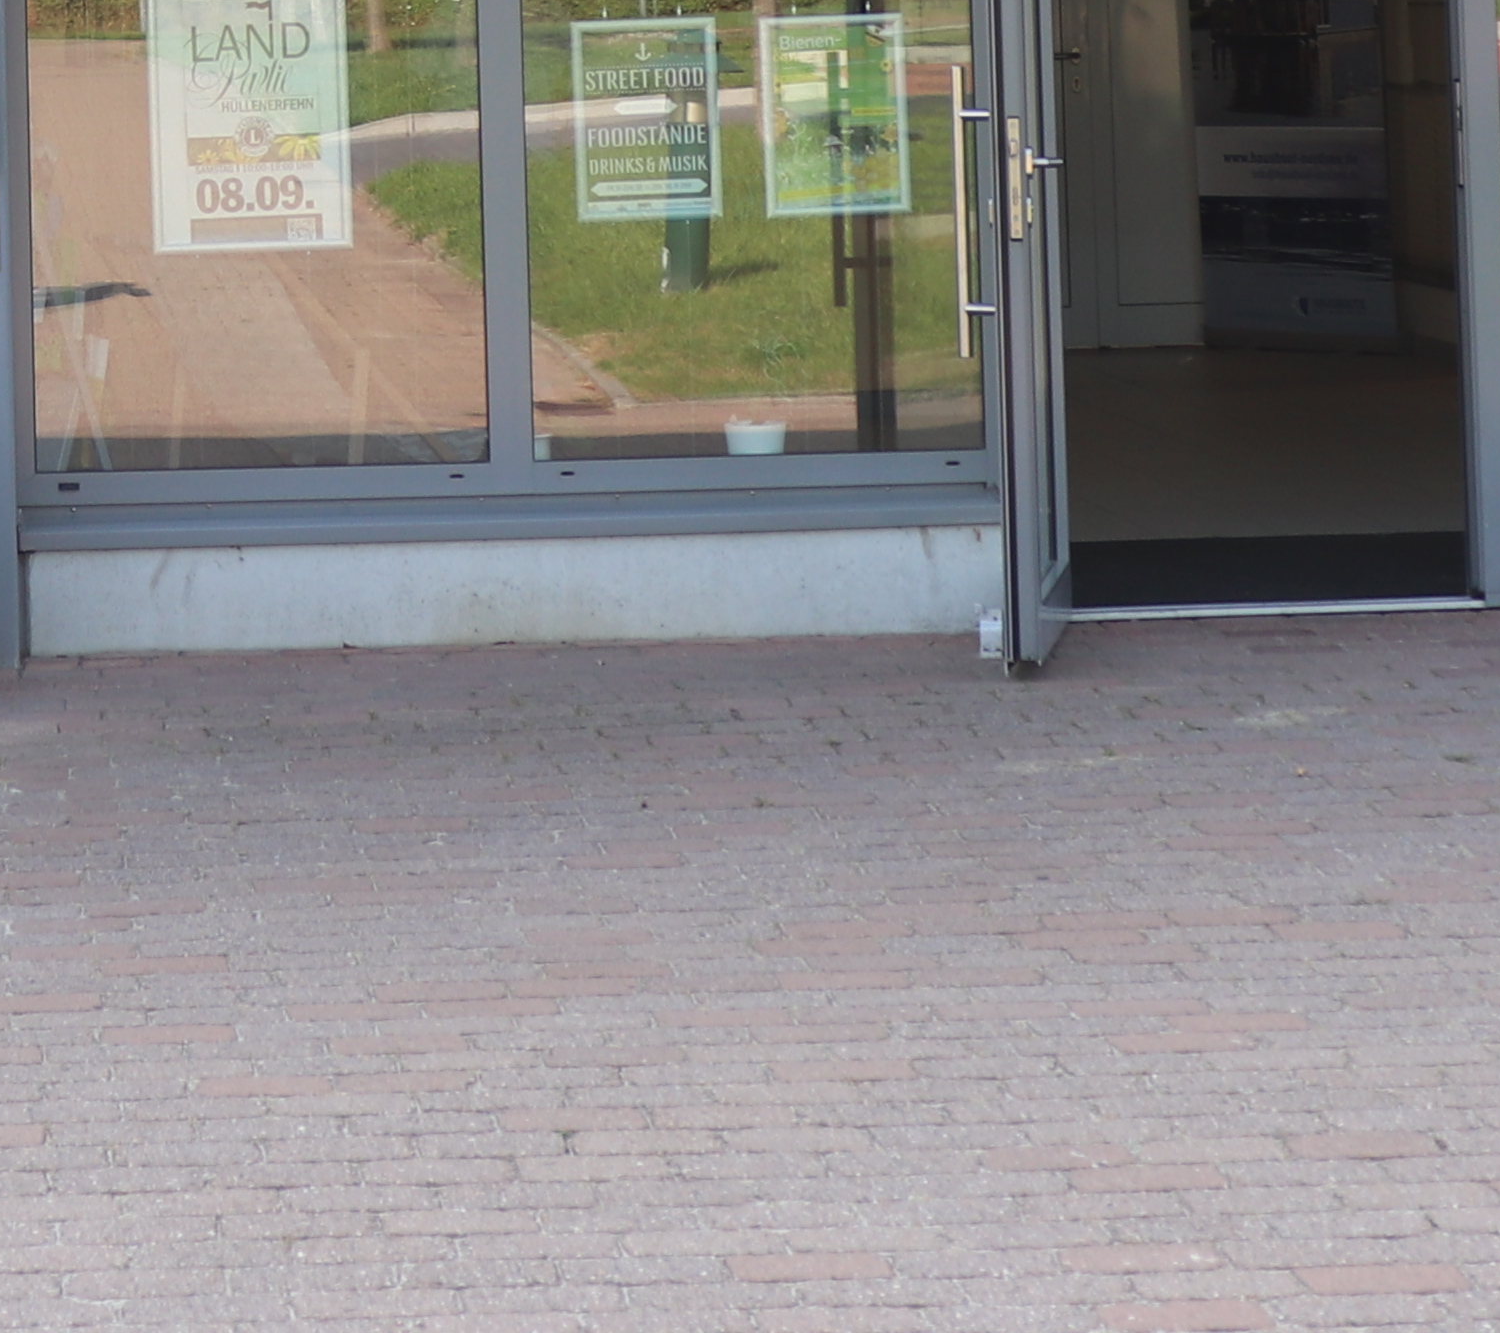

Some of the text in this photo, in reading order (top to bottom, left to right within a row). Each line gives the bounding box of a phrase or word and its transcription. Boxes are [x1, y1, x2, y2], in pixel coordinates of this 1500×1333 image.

[190, 21, 311, 62] LAND
[779, 35, 842, 50] Bienen-
[585, 66, 705, 91] STREET FOOD
[220, 97, 315, 113] HÜLLENERFEHN
[587, 121, 707, 149] FOODSTÄNDE
[195, 165, 235, 175] SAMSTAG
[297, 161, 314, 171] UHR
[589, 154, 709, 175] DRINKS & MUSIK
[195, 174, 315, 214] 08.09.
